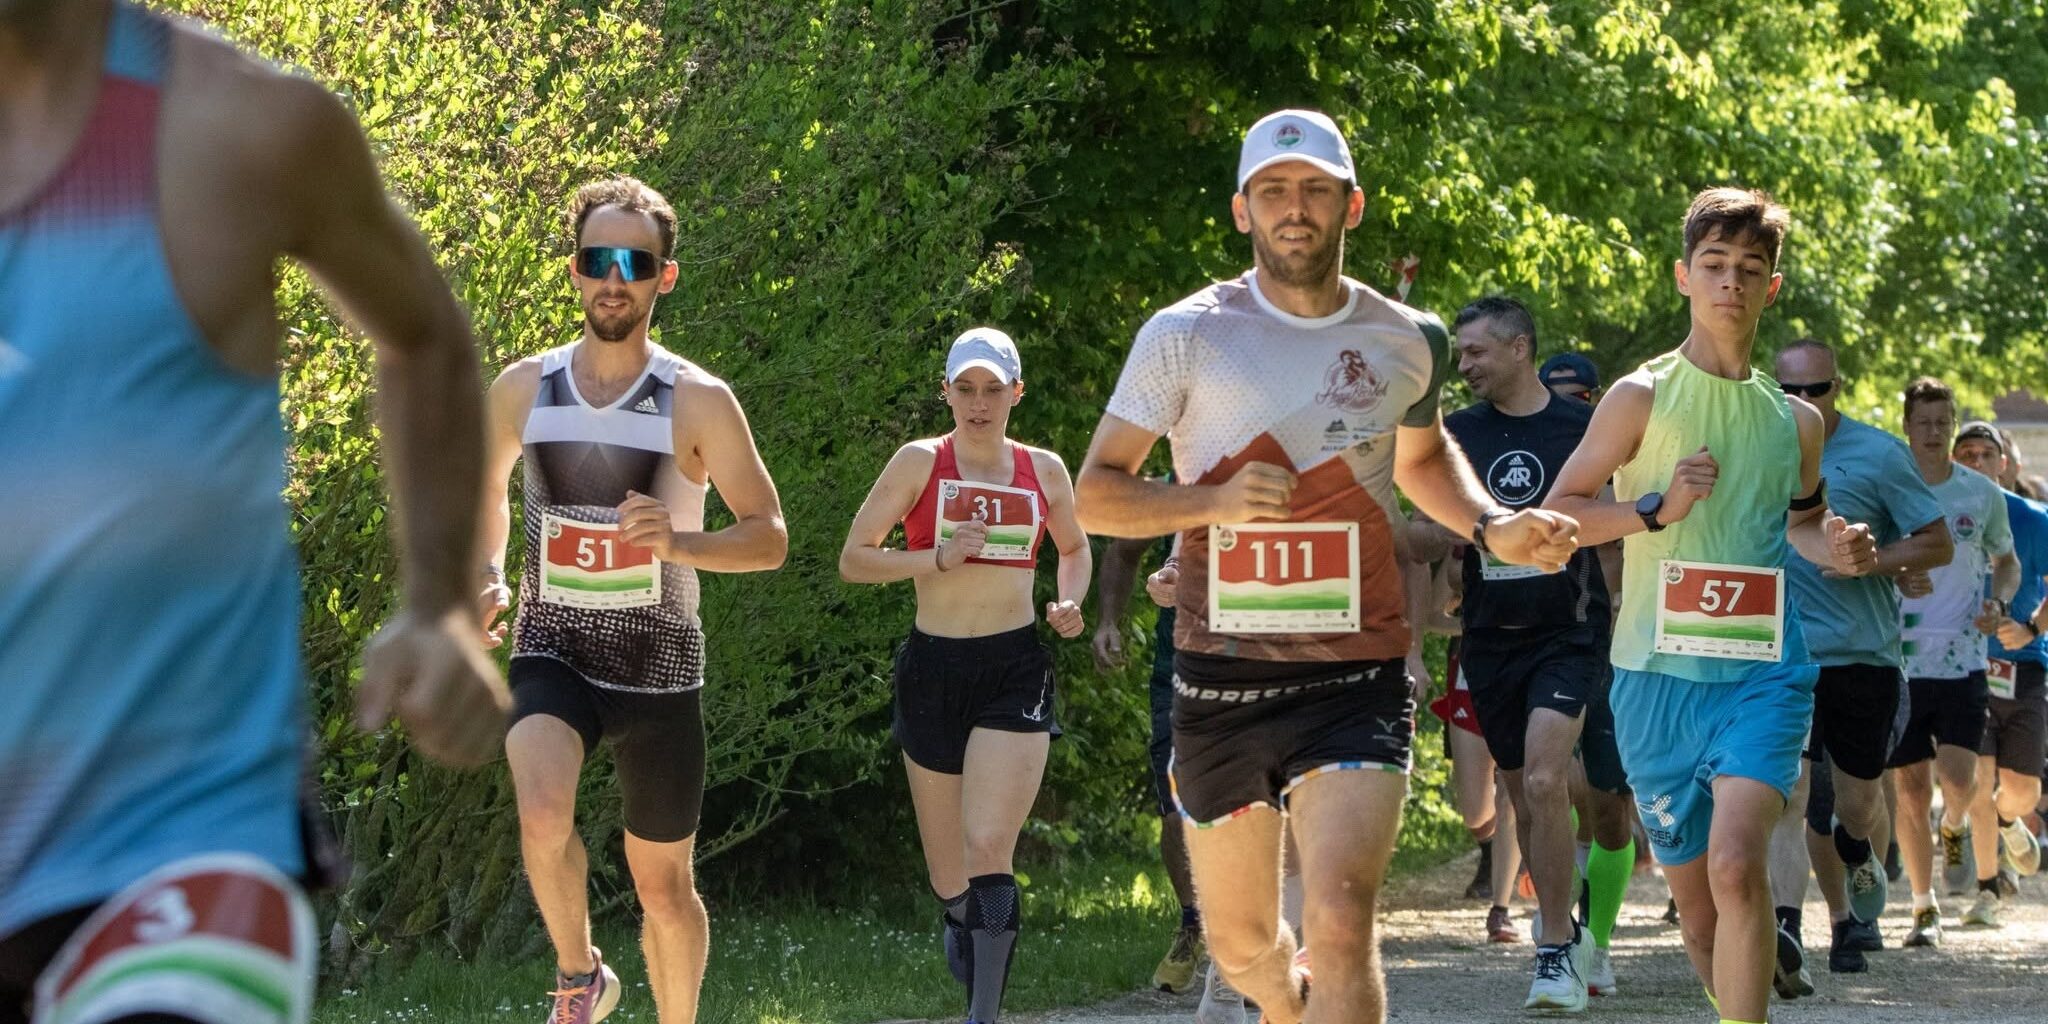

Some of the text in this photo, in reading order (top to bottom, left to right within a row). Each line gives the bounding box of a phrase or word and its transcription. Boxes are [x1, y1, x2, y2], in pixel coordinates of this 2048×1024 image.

[971, 495, 1002, 523] 31
[575, 537, 613, 568] 51
[1249, 540, 1314, 579] 111
[1698, 579, 1746, 613] 57
[133, 885, 196, 943] 3
